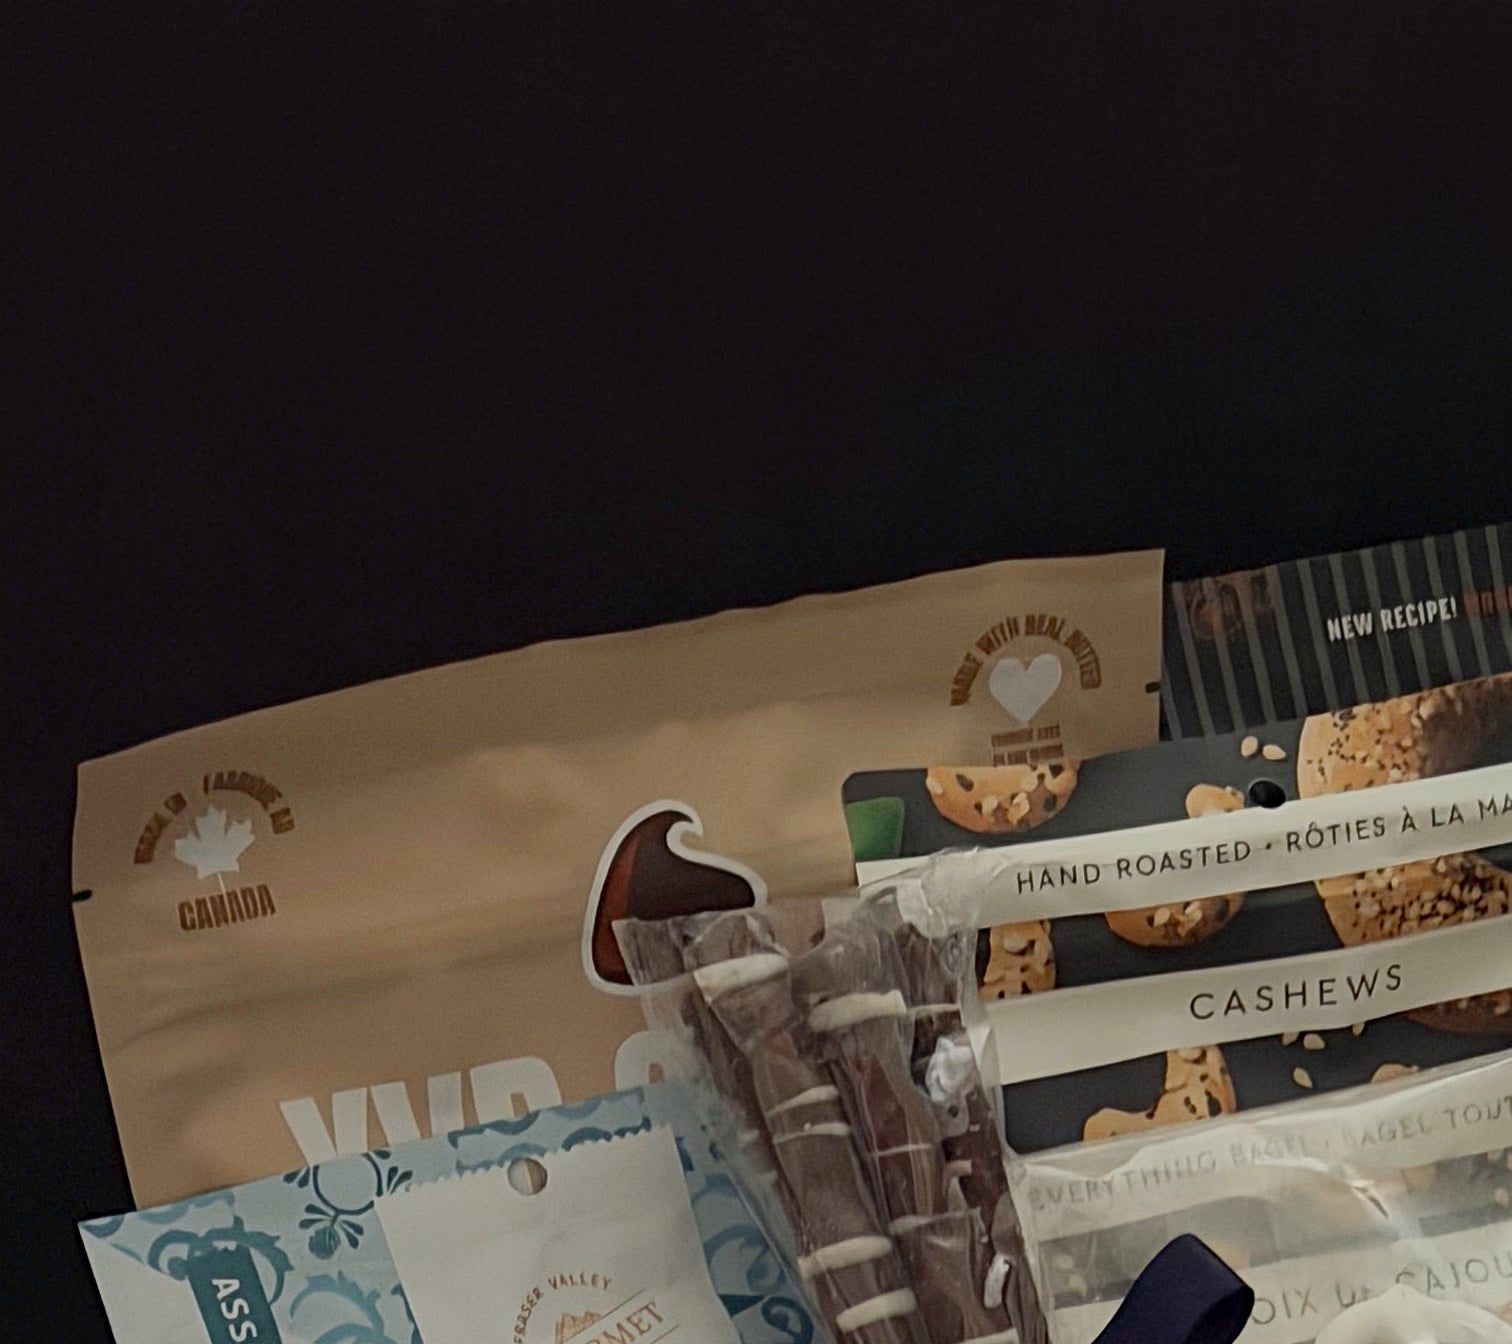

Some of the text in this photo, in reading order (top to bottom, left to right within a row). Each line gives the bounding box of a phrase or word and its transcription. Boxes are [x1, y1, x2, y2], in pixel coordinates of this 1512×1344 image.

[1326, 613, 1373, 642] NEW
[1380, 597, 1457, 632] RECIPE!
[1016, 863, 1101, 895] HAND
[1117, 841, 1251, 880] ROASTED
[1286, 818, 1387, 852] RÔTIES
[1401, 804, 1417, 833] À
[1430, 804, 1465, 828] LA
[177, 884, 276, 931] CANADA
[1190, 964, 1402, 1021] CASHEWS
[1342, 1113, 1433, 1148] AGEL
[513, 1272, 612, 1344] FRASER VALLEY
[1251, 1286, 1318, 1324] OIX
